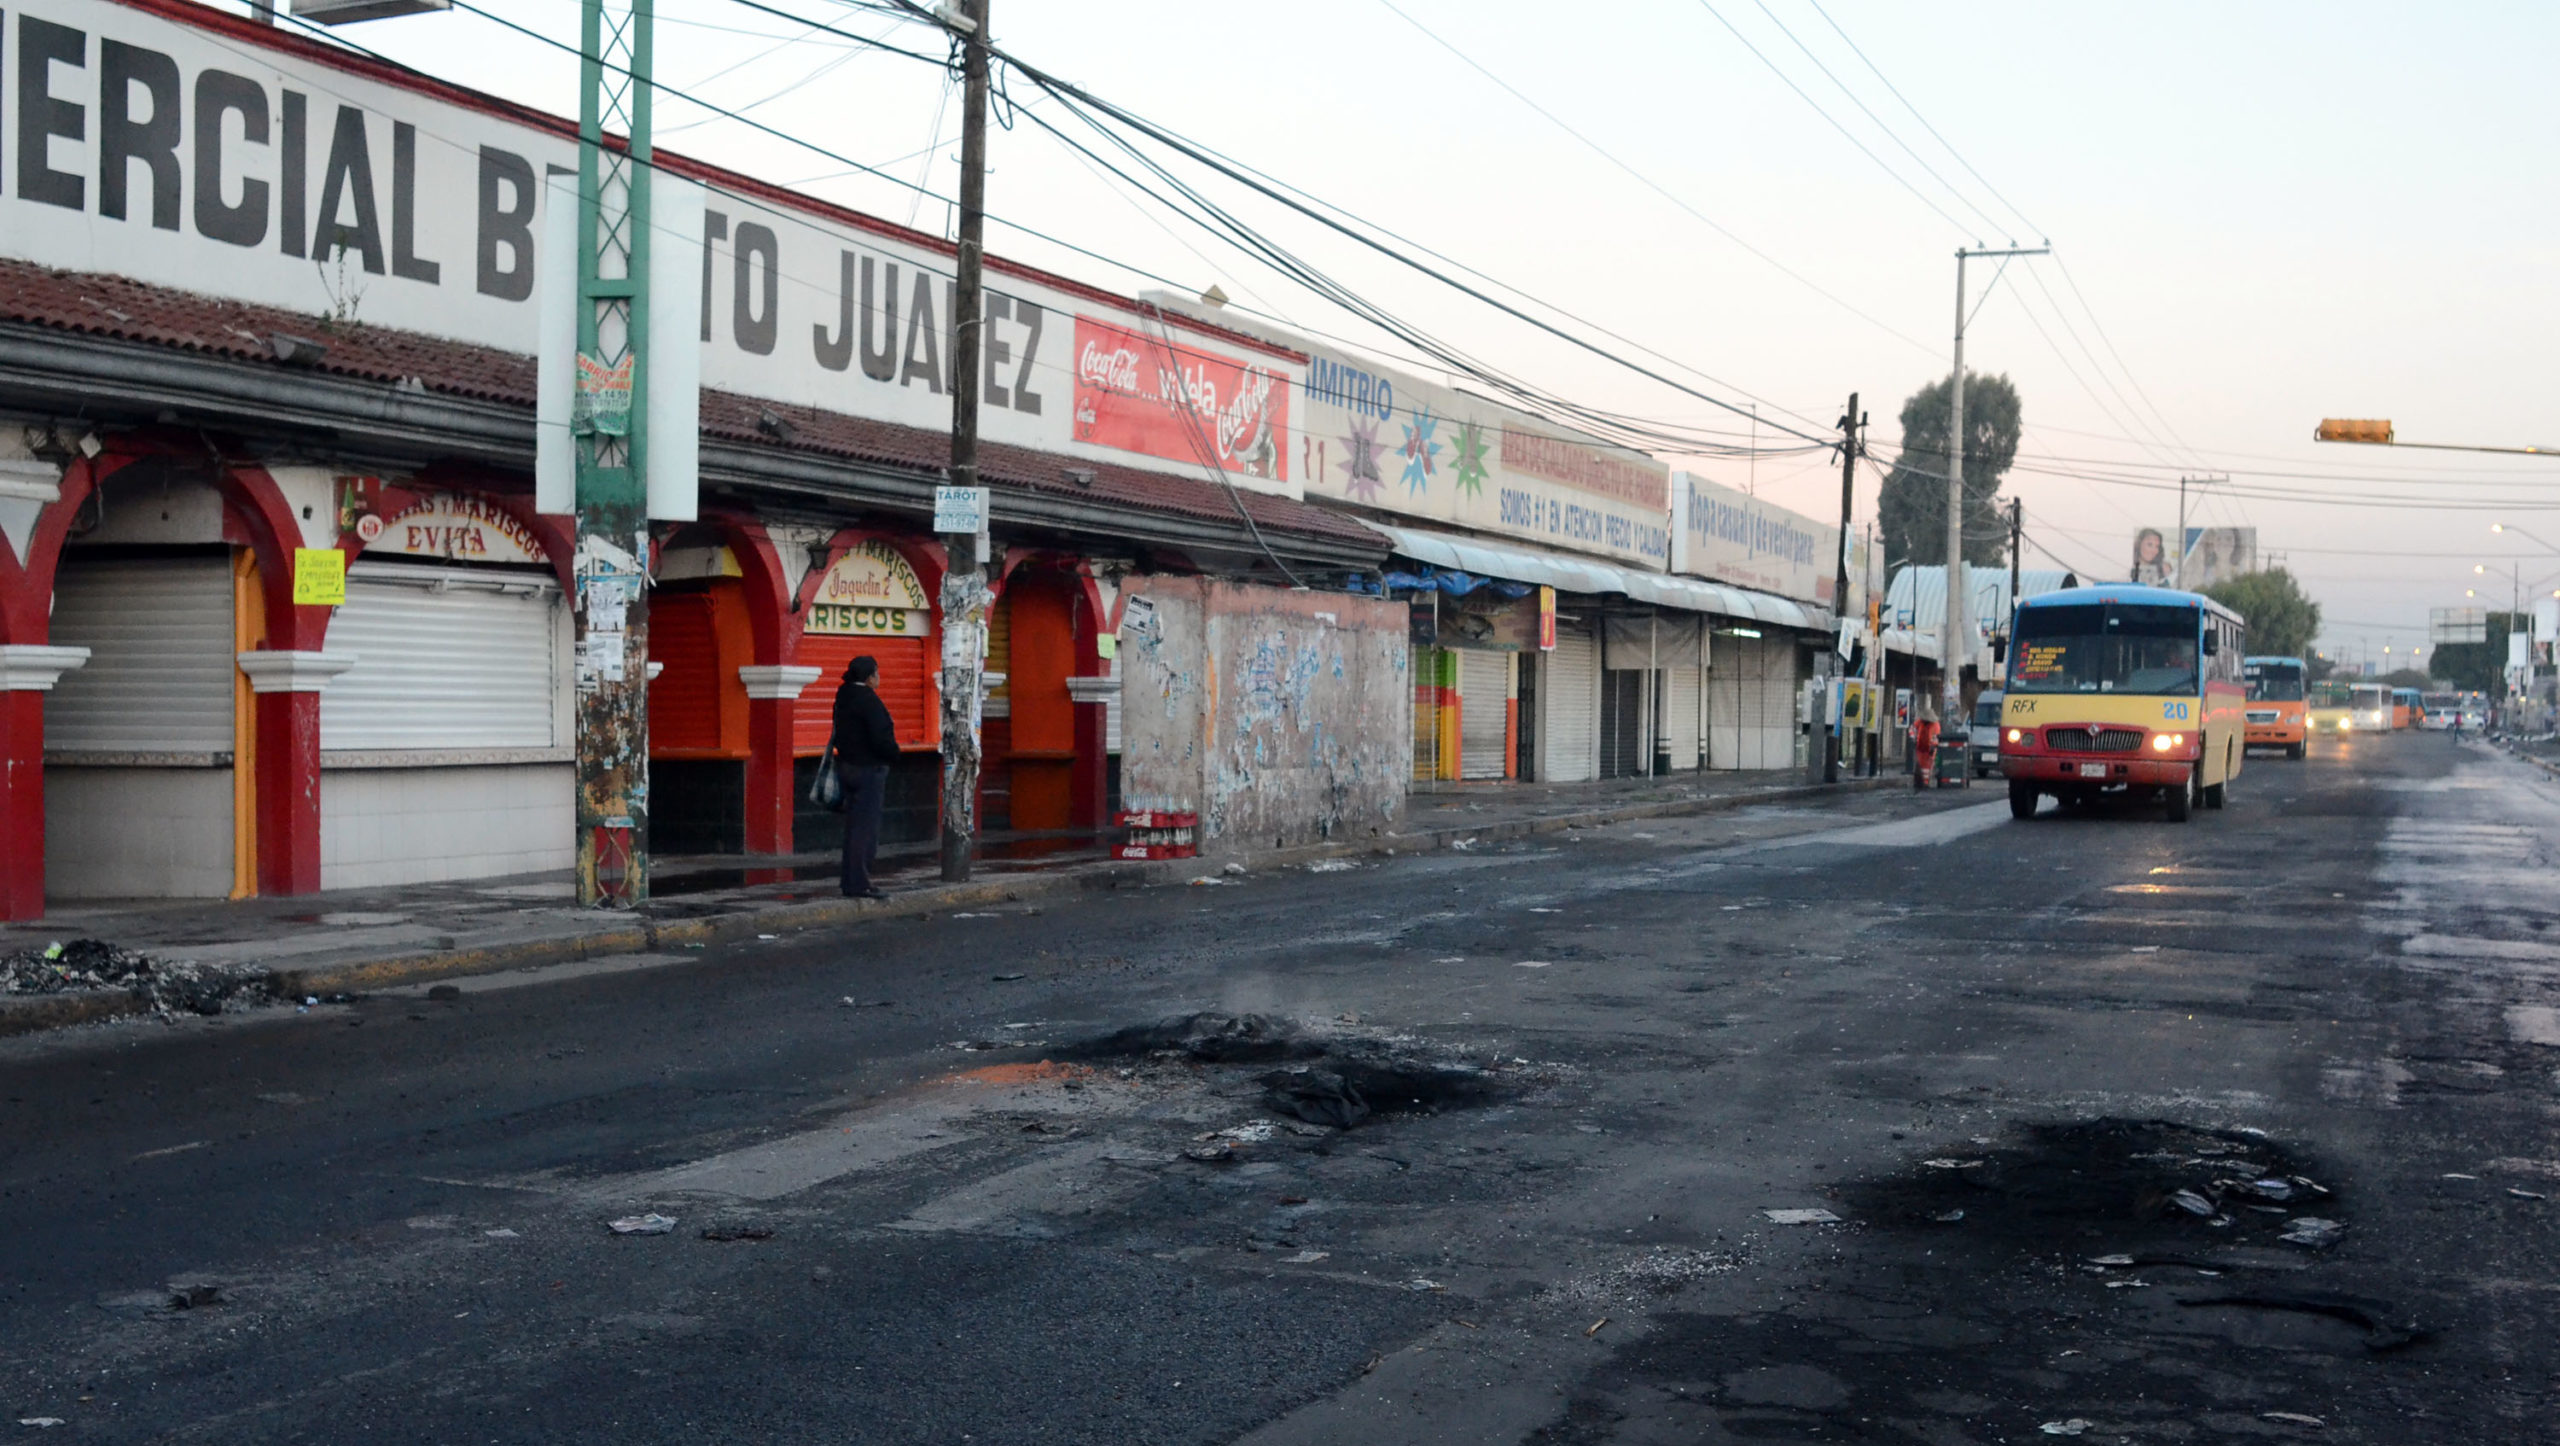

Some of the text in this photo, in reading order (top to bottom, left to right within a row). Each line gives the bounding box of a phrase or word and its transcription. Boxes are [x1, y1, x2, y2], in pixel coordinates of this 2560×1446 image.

[0, 8, 440, 285] ERCIAL
[813, 249, 1043, 416] JUAEZ
[938, 491, 977, 501] TAROT
[1688, 481, 1716, 549] Ropa
[1718, 501, 1748, 547] casual
[406, 526, 487, 556] EVITA
[452, 493, 547, 563] MARISCOS
[1500, 487, 1531, 528] SOMOS
[1550, 498, 1560, 534] EN
[1564, 503, 1602, 544] ATENCION
[1606, 513, 1631, 550] PRECIO
[1639, 522, 1667, 559] CALIDAD
[865, 538, 924, 609] MARISCOS
[882, 576, 893, 598] 2
[2011, 700, 2037, 713] RFX
[2163, 702, 2188, 720] 20
